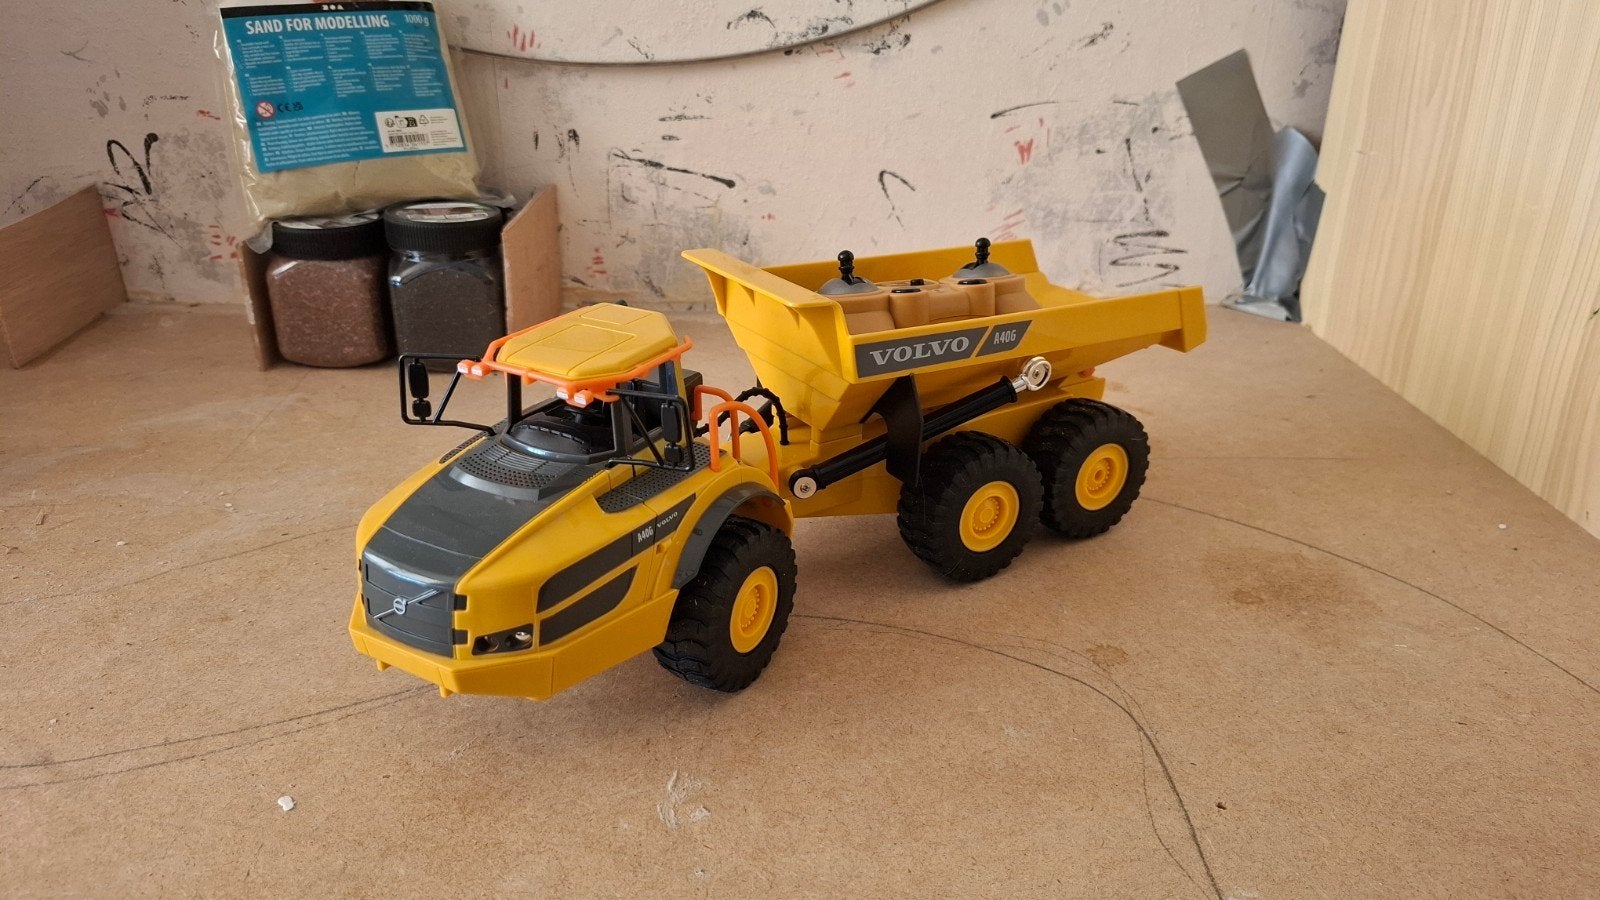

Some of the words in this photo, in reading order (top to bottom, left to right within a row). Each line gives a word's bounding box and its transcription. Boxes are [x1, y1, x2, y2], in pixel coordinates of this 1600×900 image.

[245, 19, 283, 35] SAND
[286, 17, 312, 32] FOR
[315, 15, 389, 30] MODELLING
[993, 329, 1017, 345] A40G
[870, 336, 970, 366] VOLVO
[656, 511, 678, 528] VOLVO
[637, 526, 654, 543] A40G
